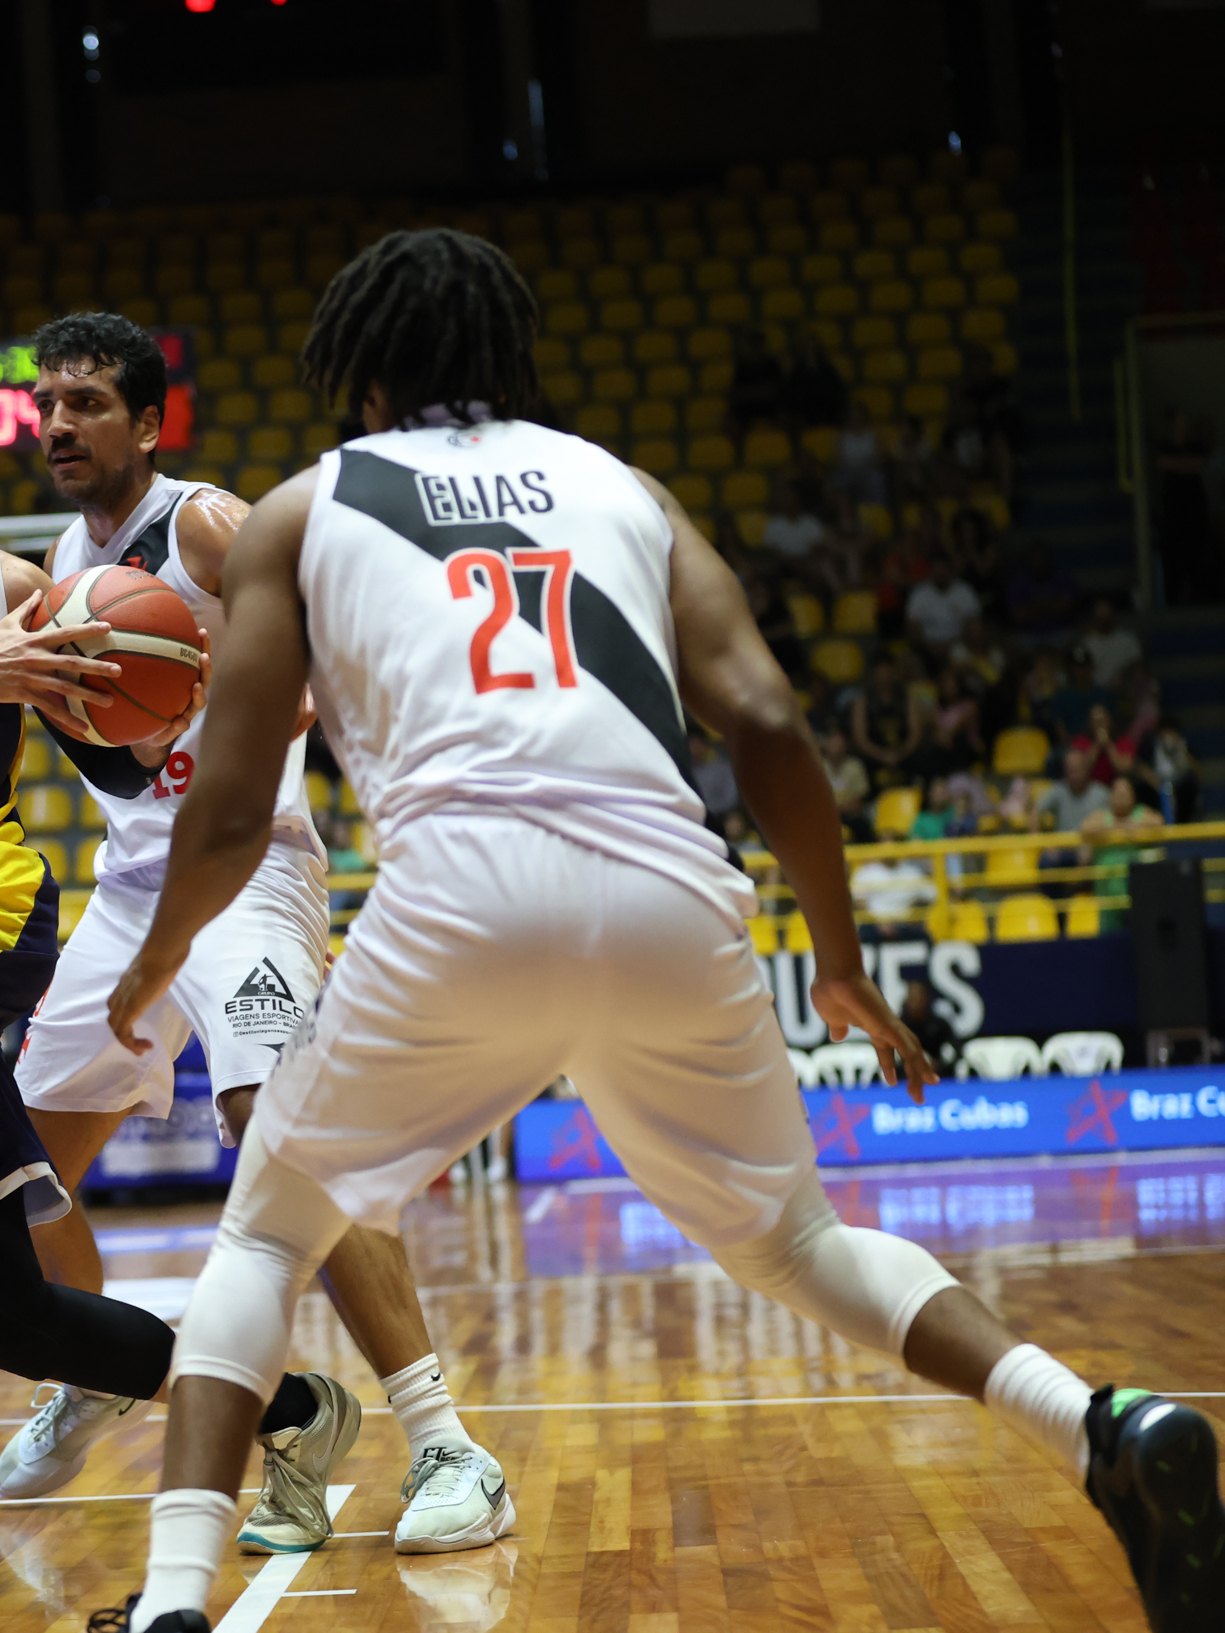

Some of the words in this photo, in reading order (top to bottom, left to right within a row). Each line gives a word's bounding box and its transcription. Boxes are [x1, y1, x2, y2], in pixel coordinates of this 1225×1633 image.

[421, 470, 555, 523] ELIAS
[447, 551, 578, 694] 27
[152, 751, 195, 799] 19
[225, 998, 304, 1019] ESTILO
[228, 1013, 260, 1022] VIAGENS
[872, 1103, 936, 1134] Braz
[939, 1097, 1029, 1132] Cubas
[1130, 1089, 1194, 1121] Braz
